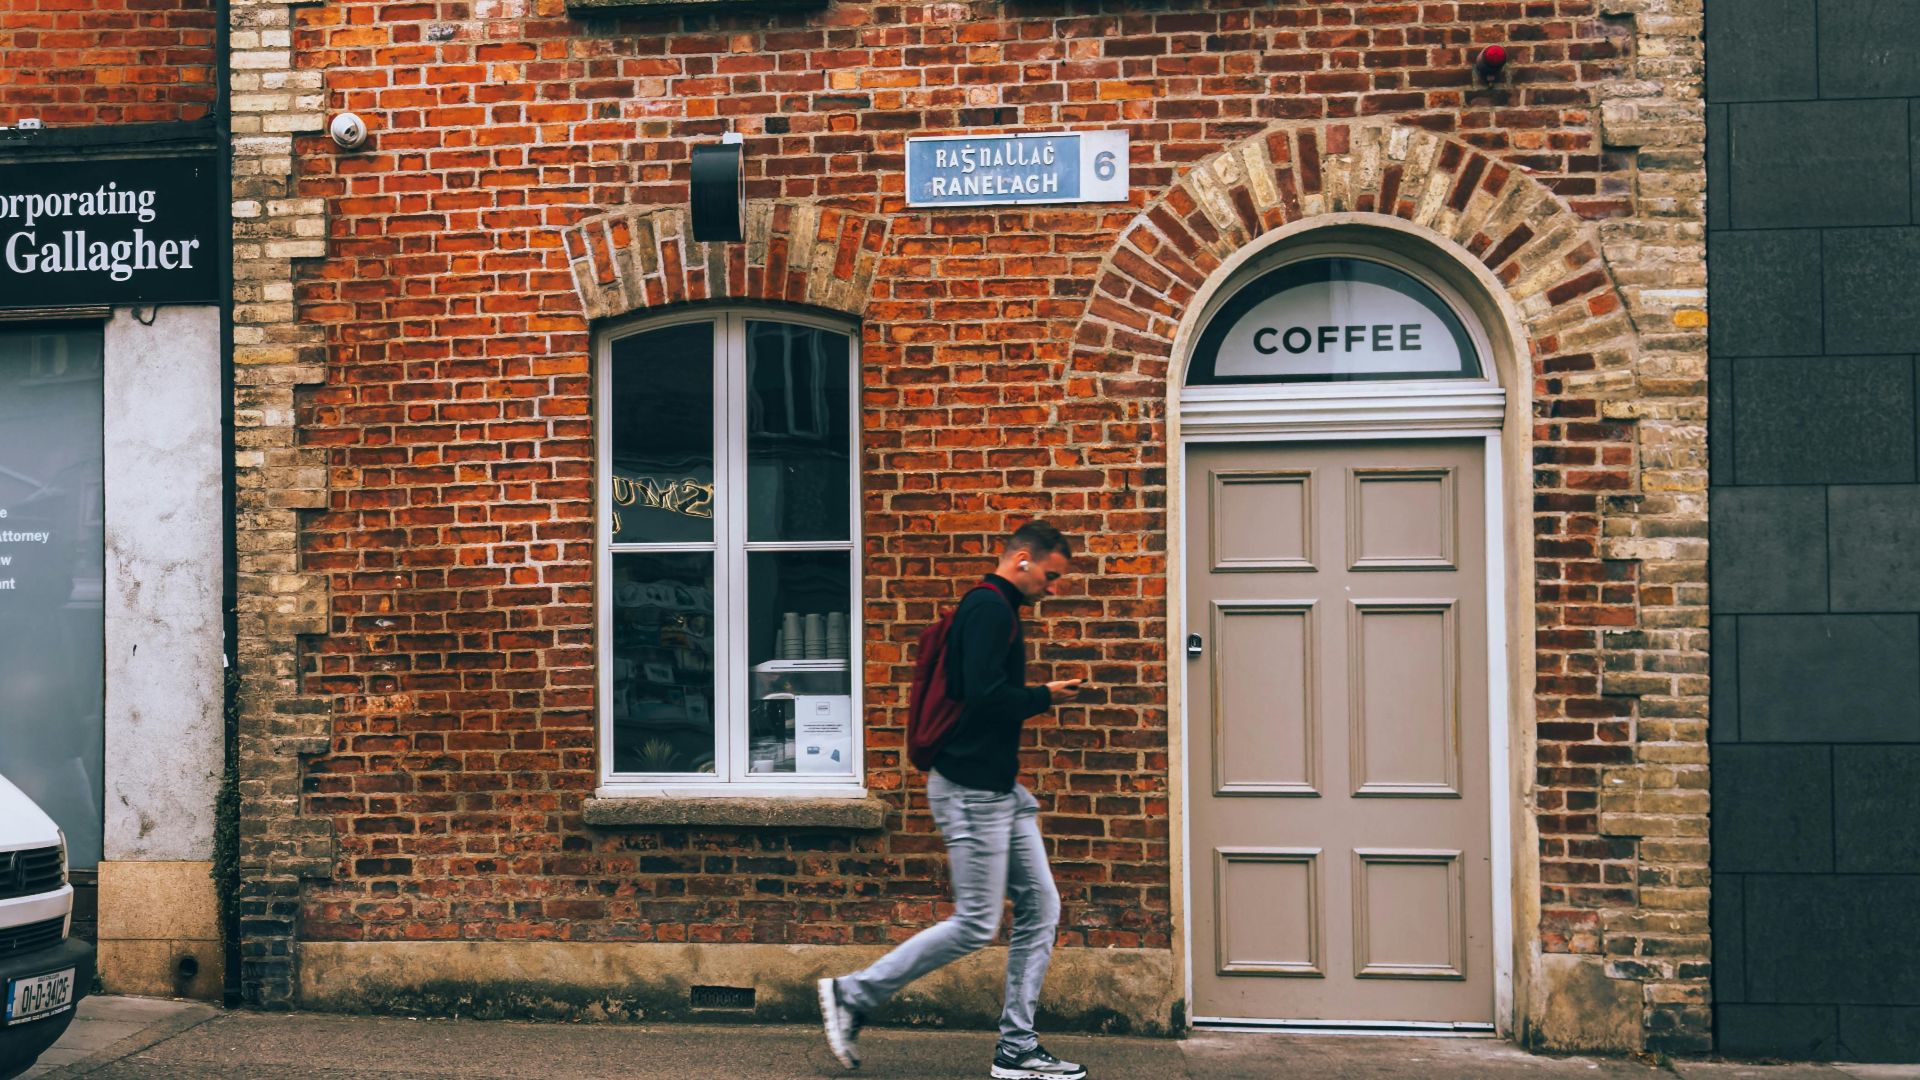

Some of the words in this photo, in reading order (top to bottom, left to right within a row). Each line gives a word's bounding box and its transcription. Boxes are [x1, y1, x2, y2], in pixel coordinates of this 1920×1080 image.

[1094, 151, 1116, 181] 6
[932, 173, 1058, 196] RANELAGH
[5, 229, 200, 281] Gallagher
[1253, 324, 1421, 355] COFFEE
[0, 530, 49, 544] ttorney
